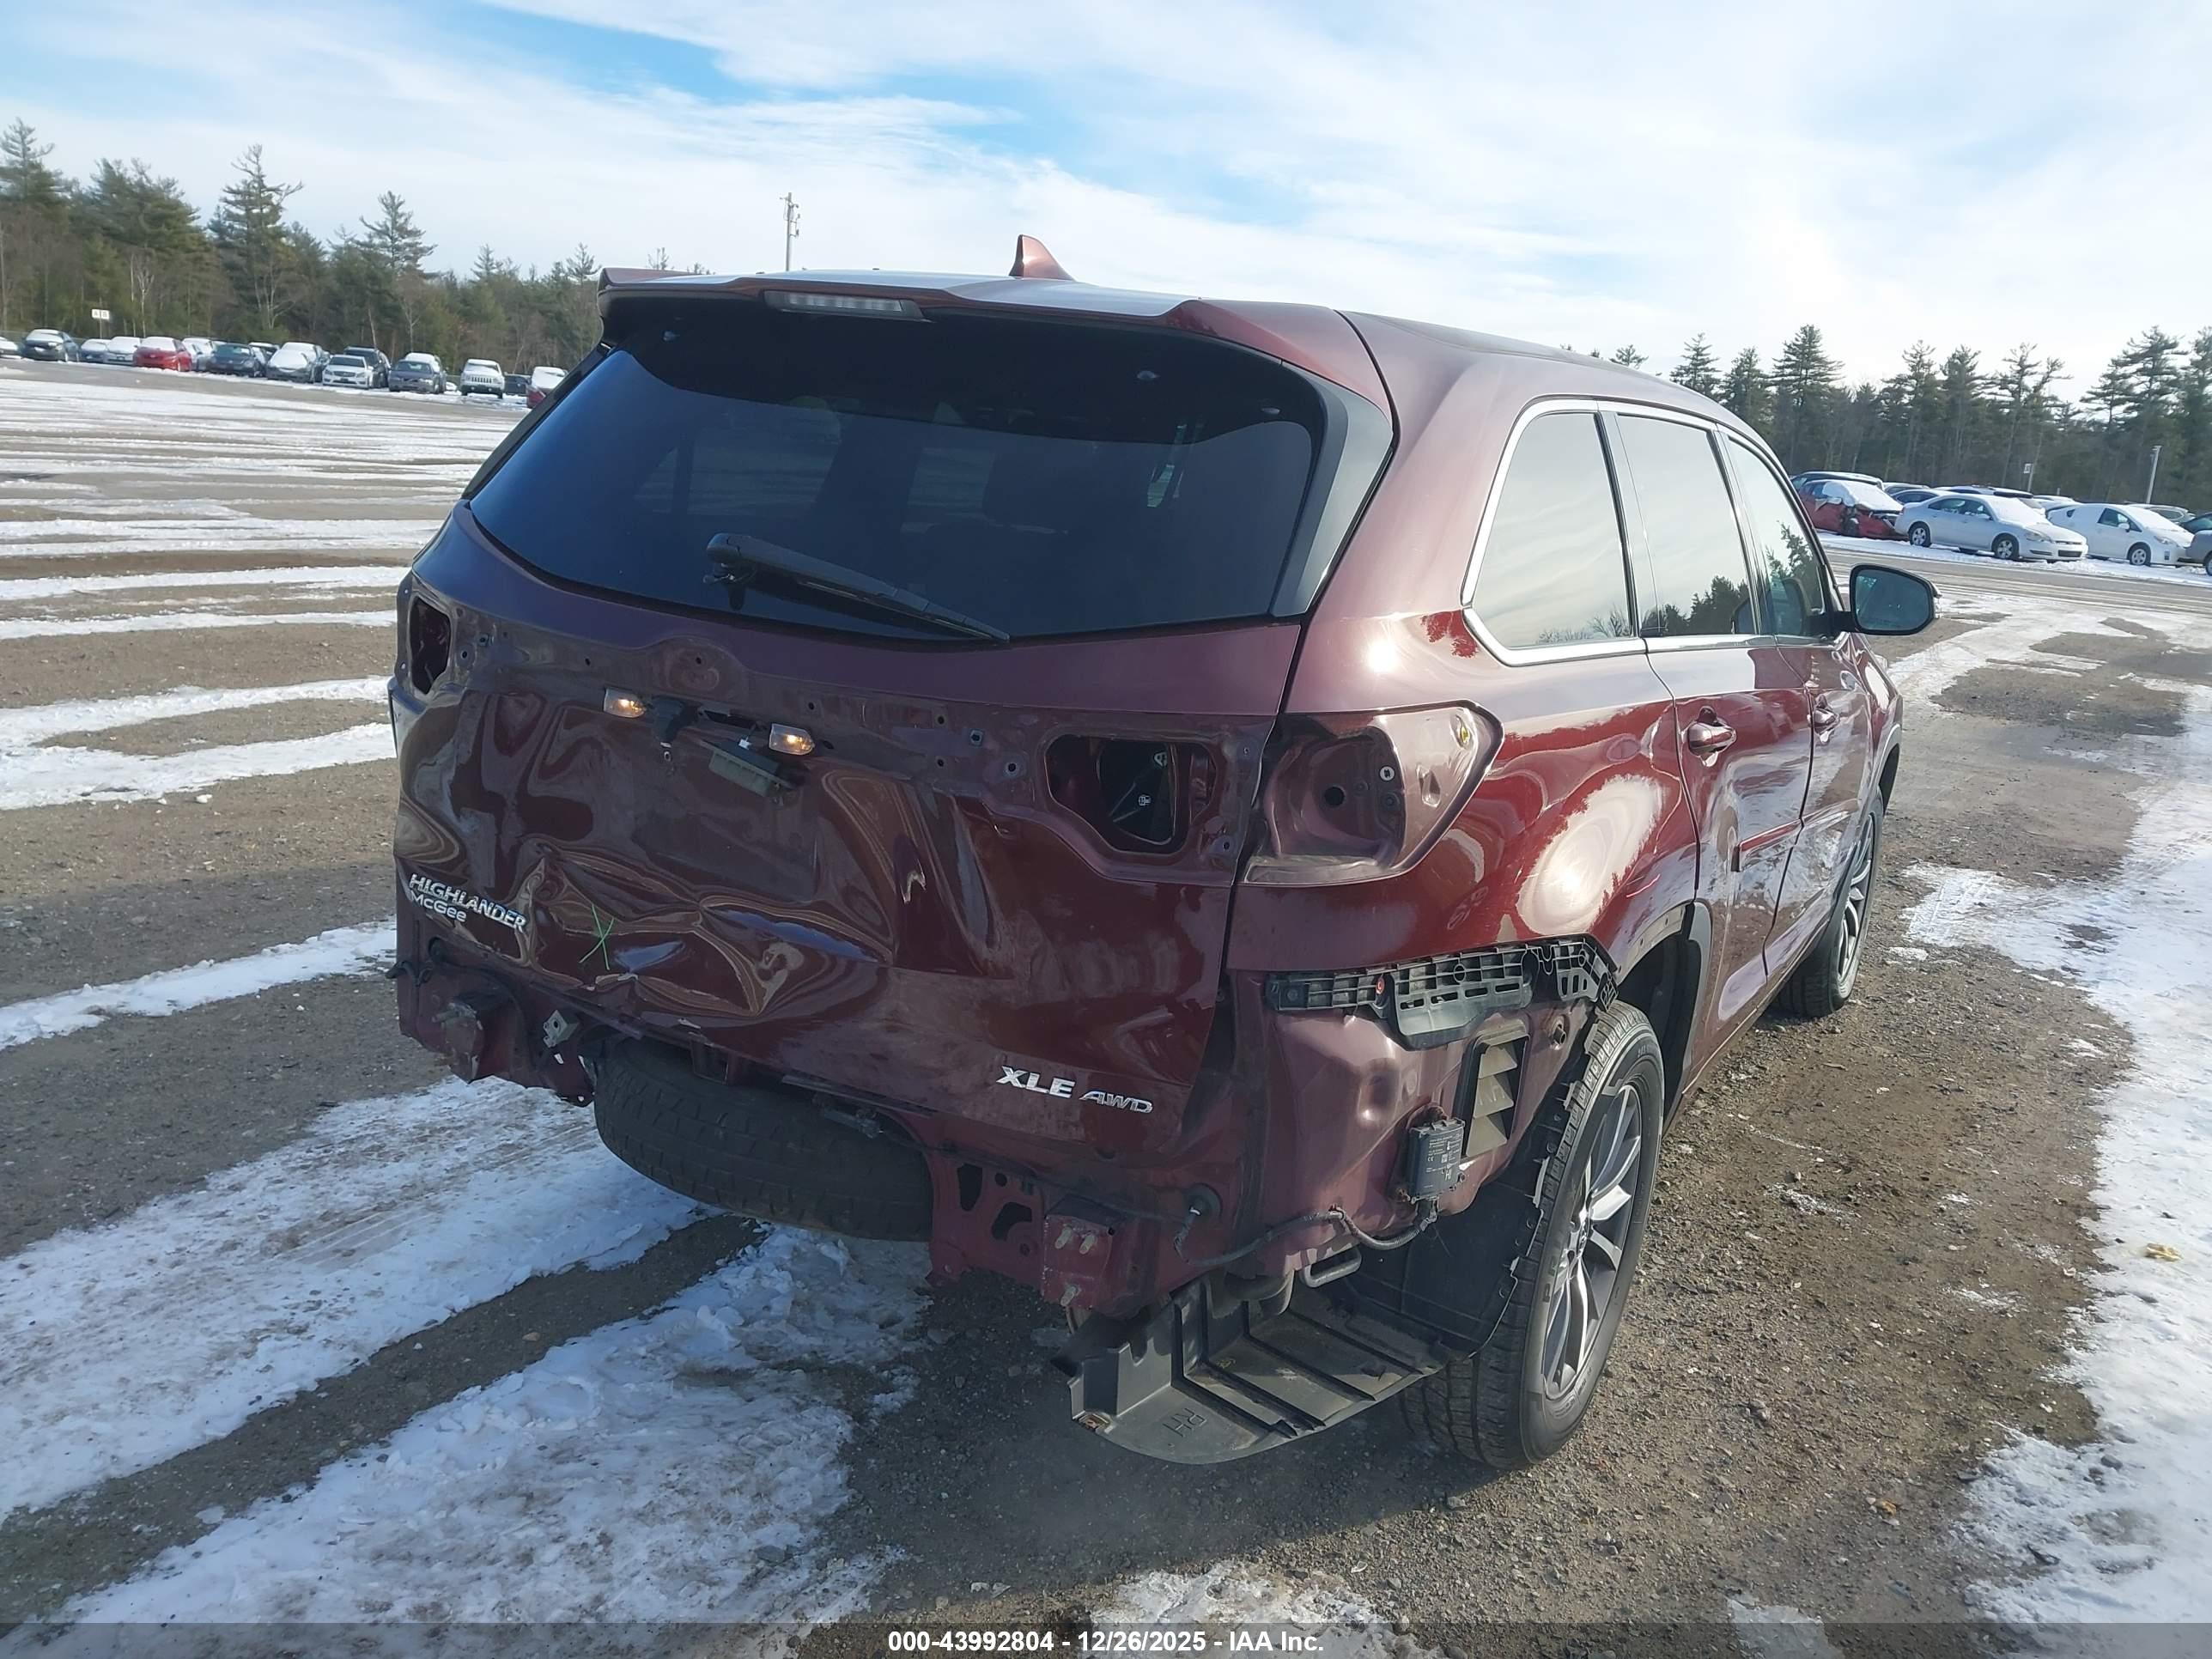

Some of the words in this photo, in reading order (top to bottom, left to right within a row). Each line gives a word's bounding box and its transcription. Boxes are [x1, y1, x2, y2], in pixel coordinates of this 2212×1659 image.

[409, 873, 526, 933] HIGHLANDER
[410, 890, 467, 922] McGee
[996, 1066, 1076, 1098] XLE
[1079, 1091, 1153, 1114] AWD
[1162, 1407, 1207, 1438] RH
